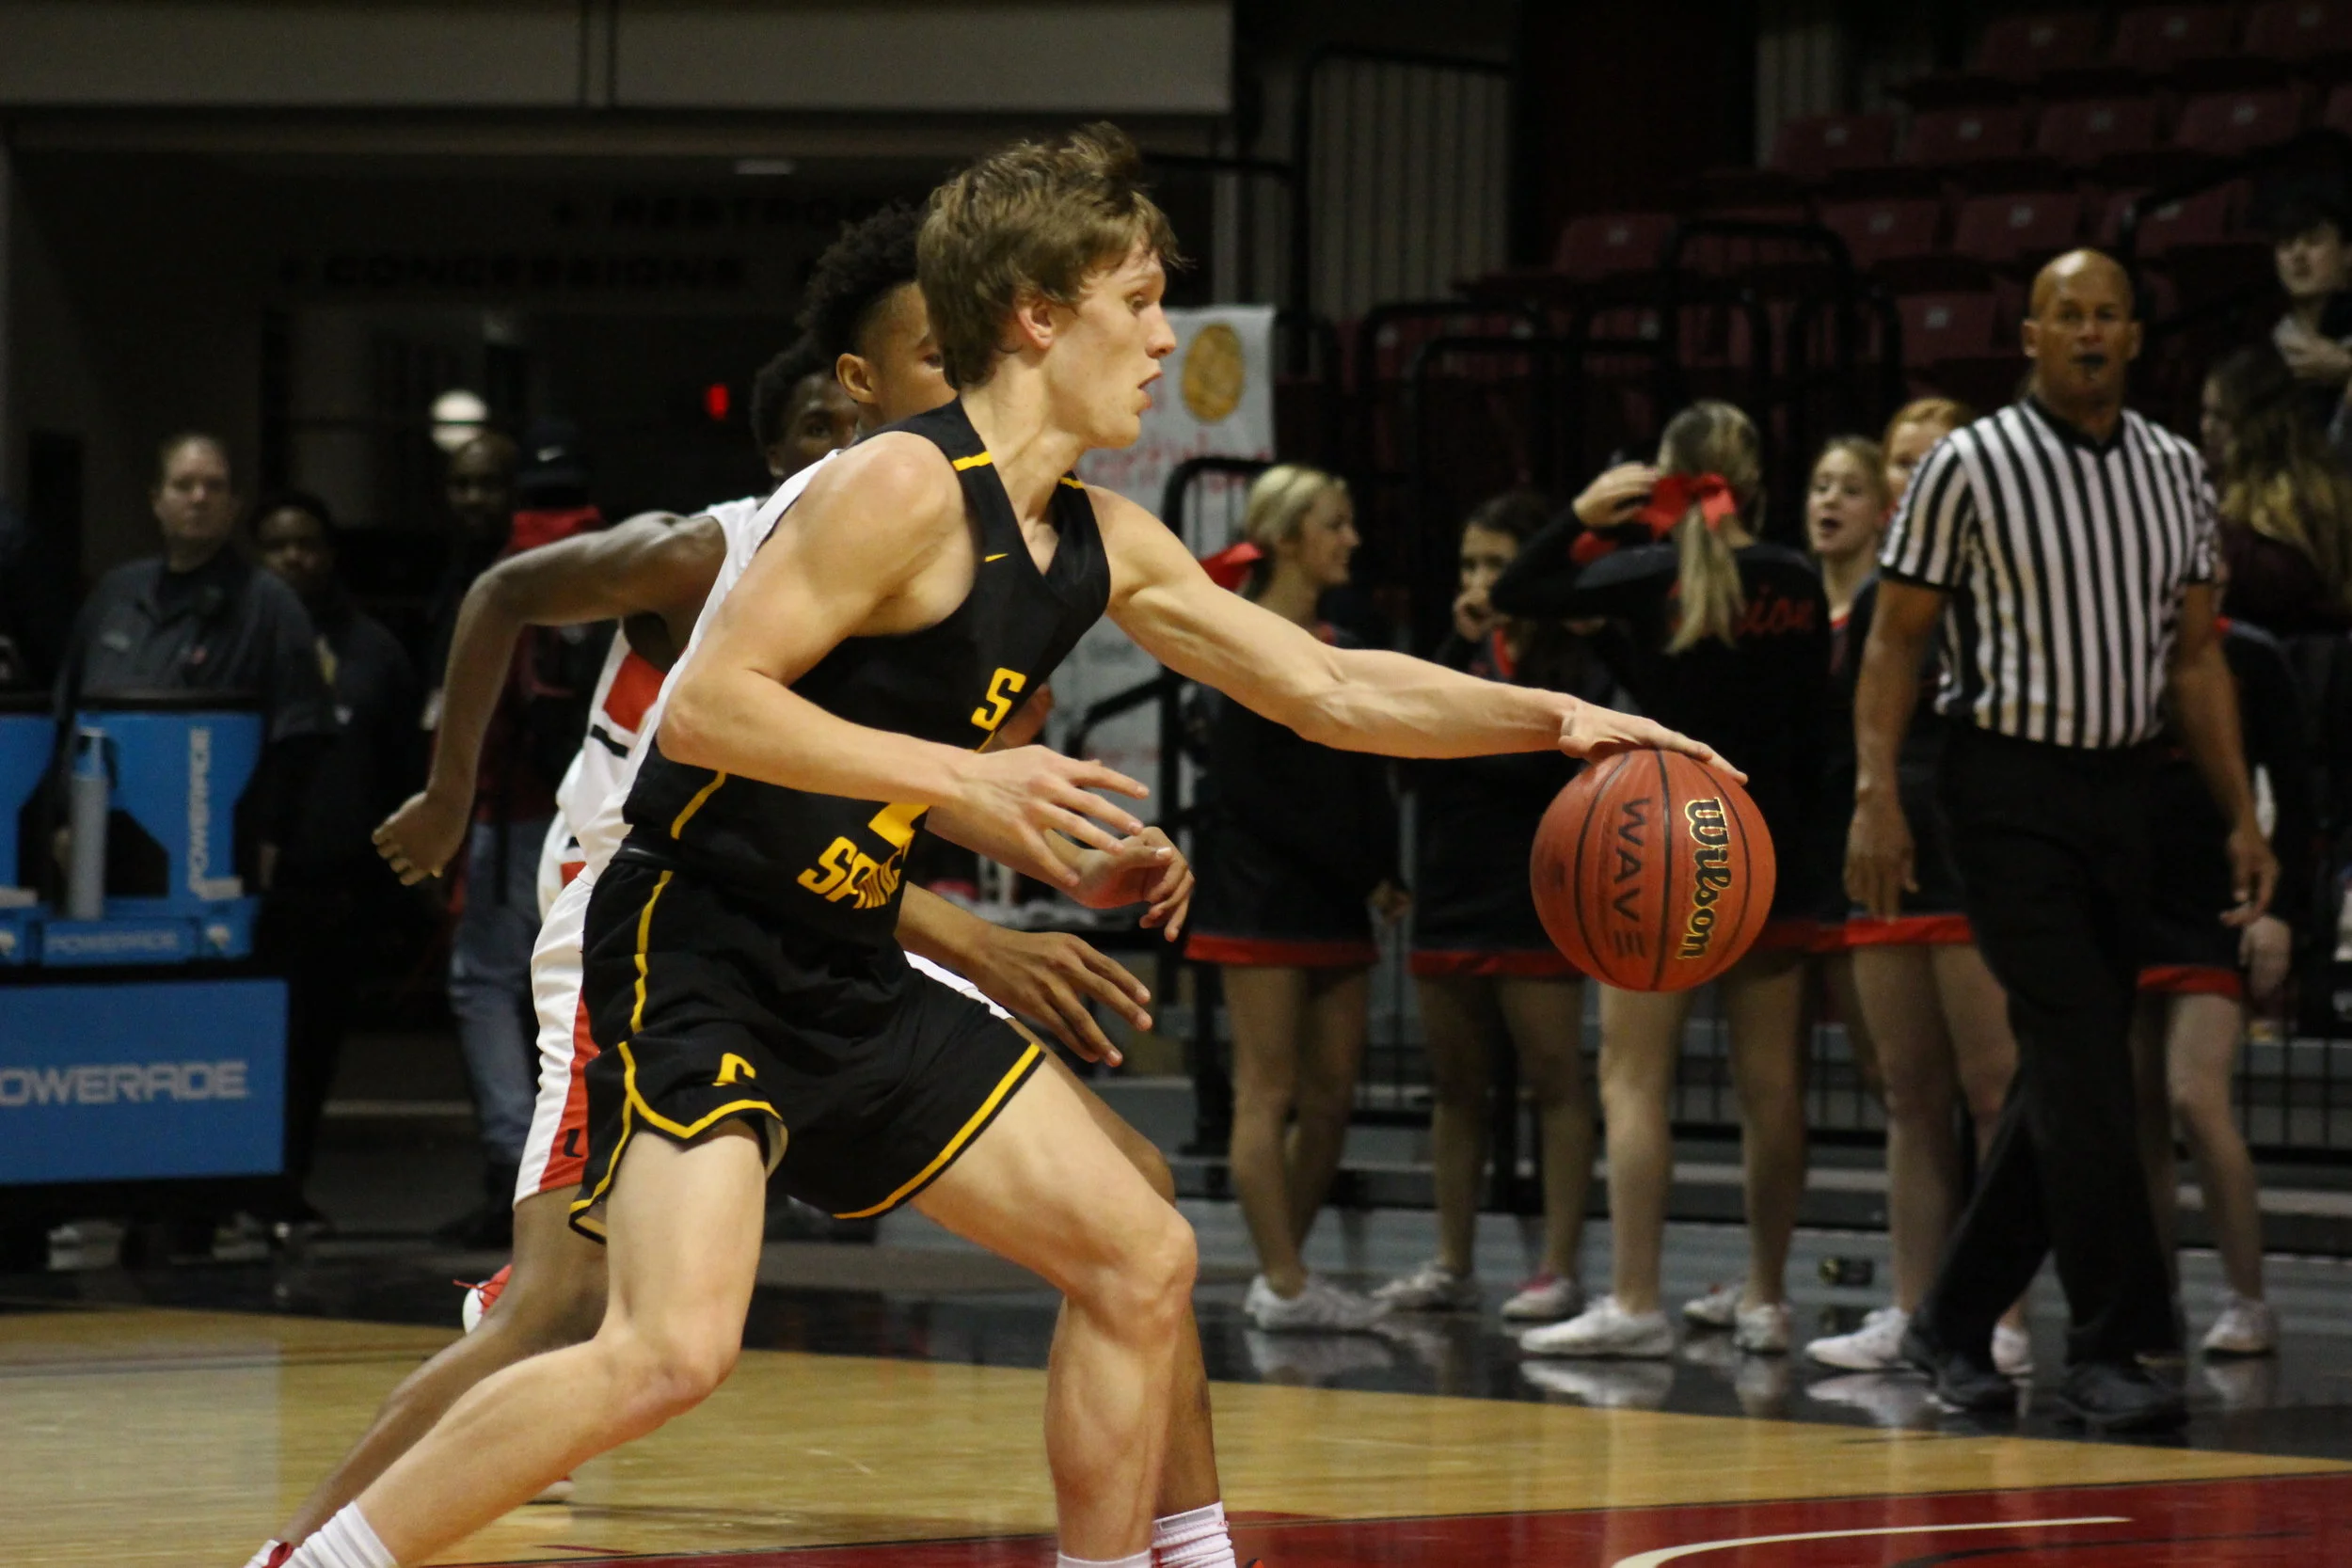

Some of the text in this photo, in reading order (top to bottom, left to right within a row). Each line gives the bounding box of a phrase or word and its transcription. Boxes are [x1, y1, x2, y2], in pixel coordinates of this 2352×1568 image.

[1613, 796, 1651, 958] WAVE
[1676, 797, 1732, 960] Wilson
[0, 1060, 249, 1106] OWERADE
